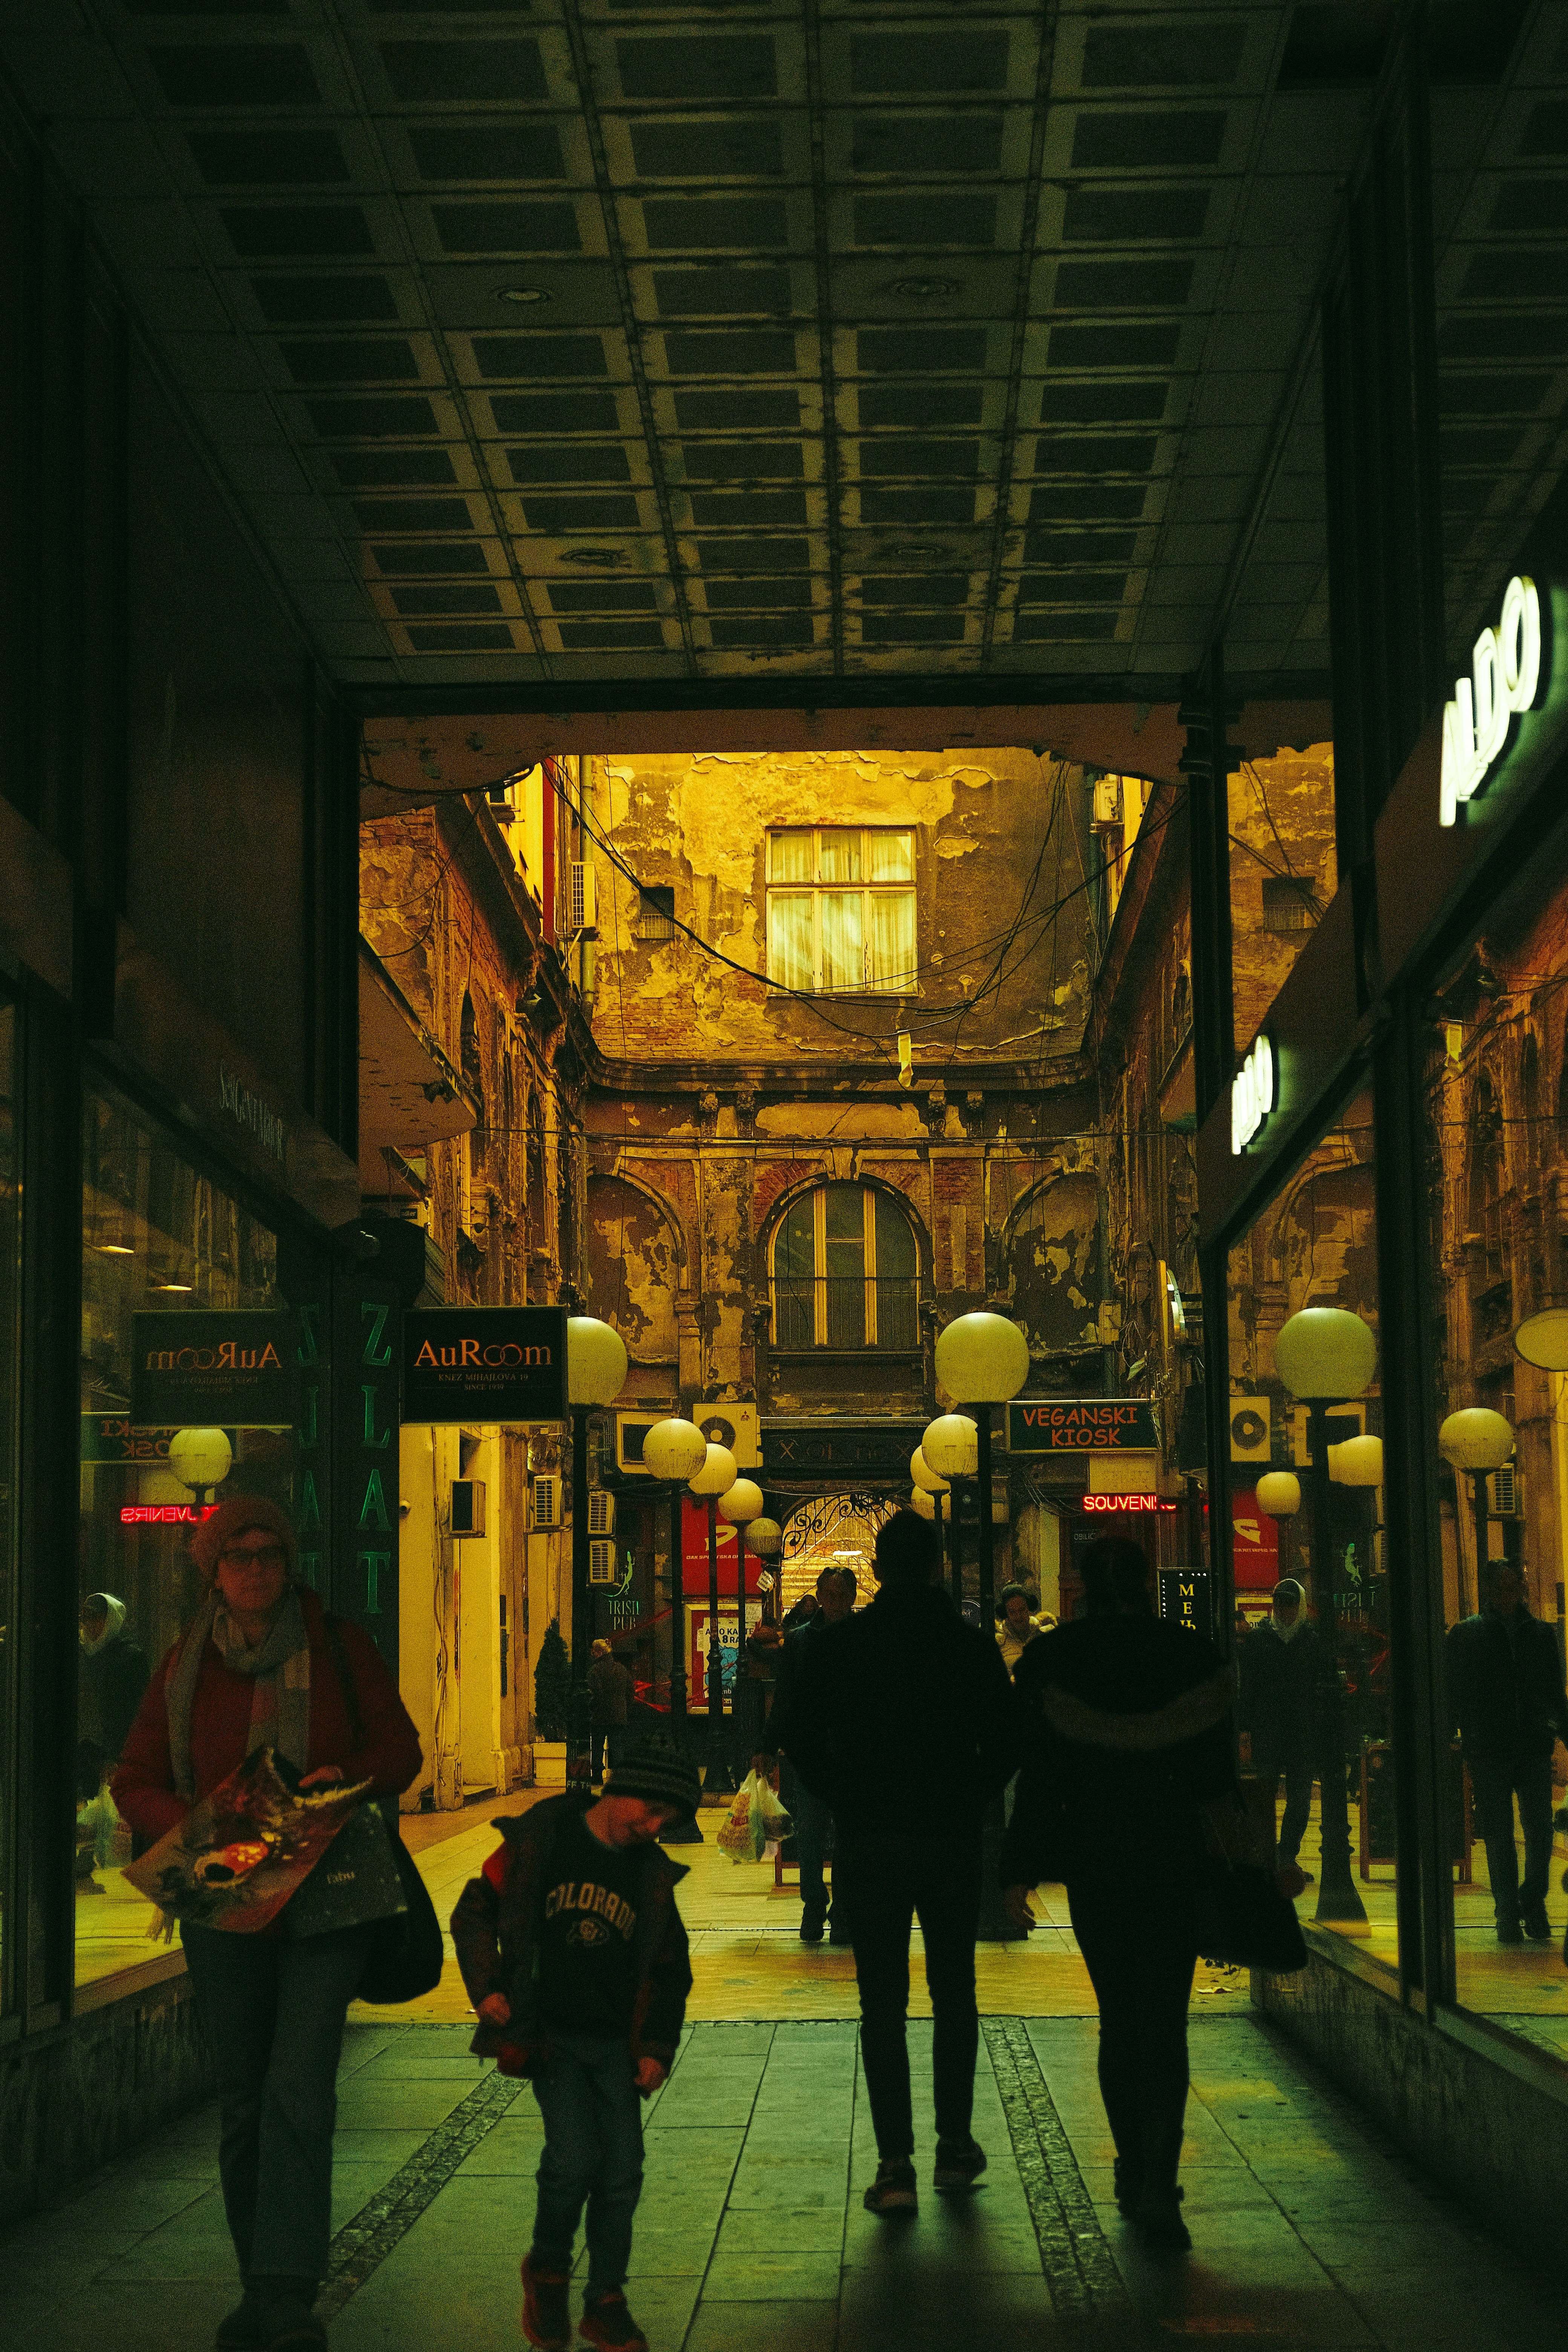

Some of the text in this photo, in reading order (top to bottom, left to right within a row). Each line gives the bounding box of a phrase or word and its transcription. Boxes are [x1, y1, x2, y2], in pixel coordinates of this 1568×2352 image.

[413, 1338, 553, 1367] AuRoom
[465, 1373, 516, 1383] MIHAJLOVA
[1022, 1407, 1138, 1427] VEGANSKI
[1051, 1427, 1121, 1447] KIOSK
[356, 1302, 394, 1644] ZLAT
[608, 1600, 640, 1615] IRISH
[613, 1616, 636, 1631] PUB
[722, 1635, 728, 1643] 8
